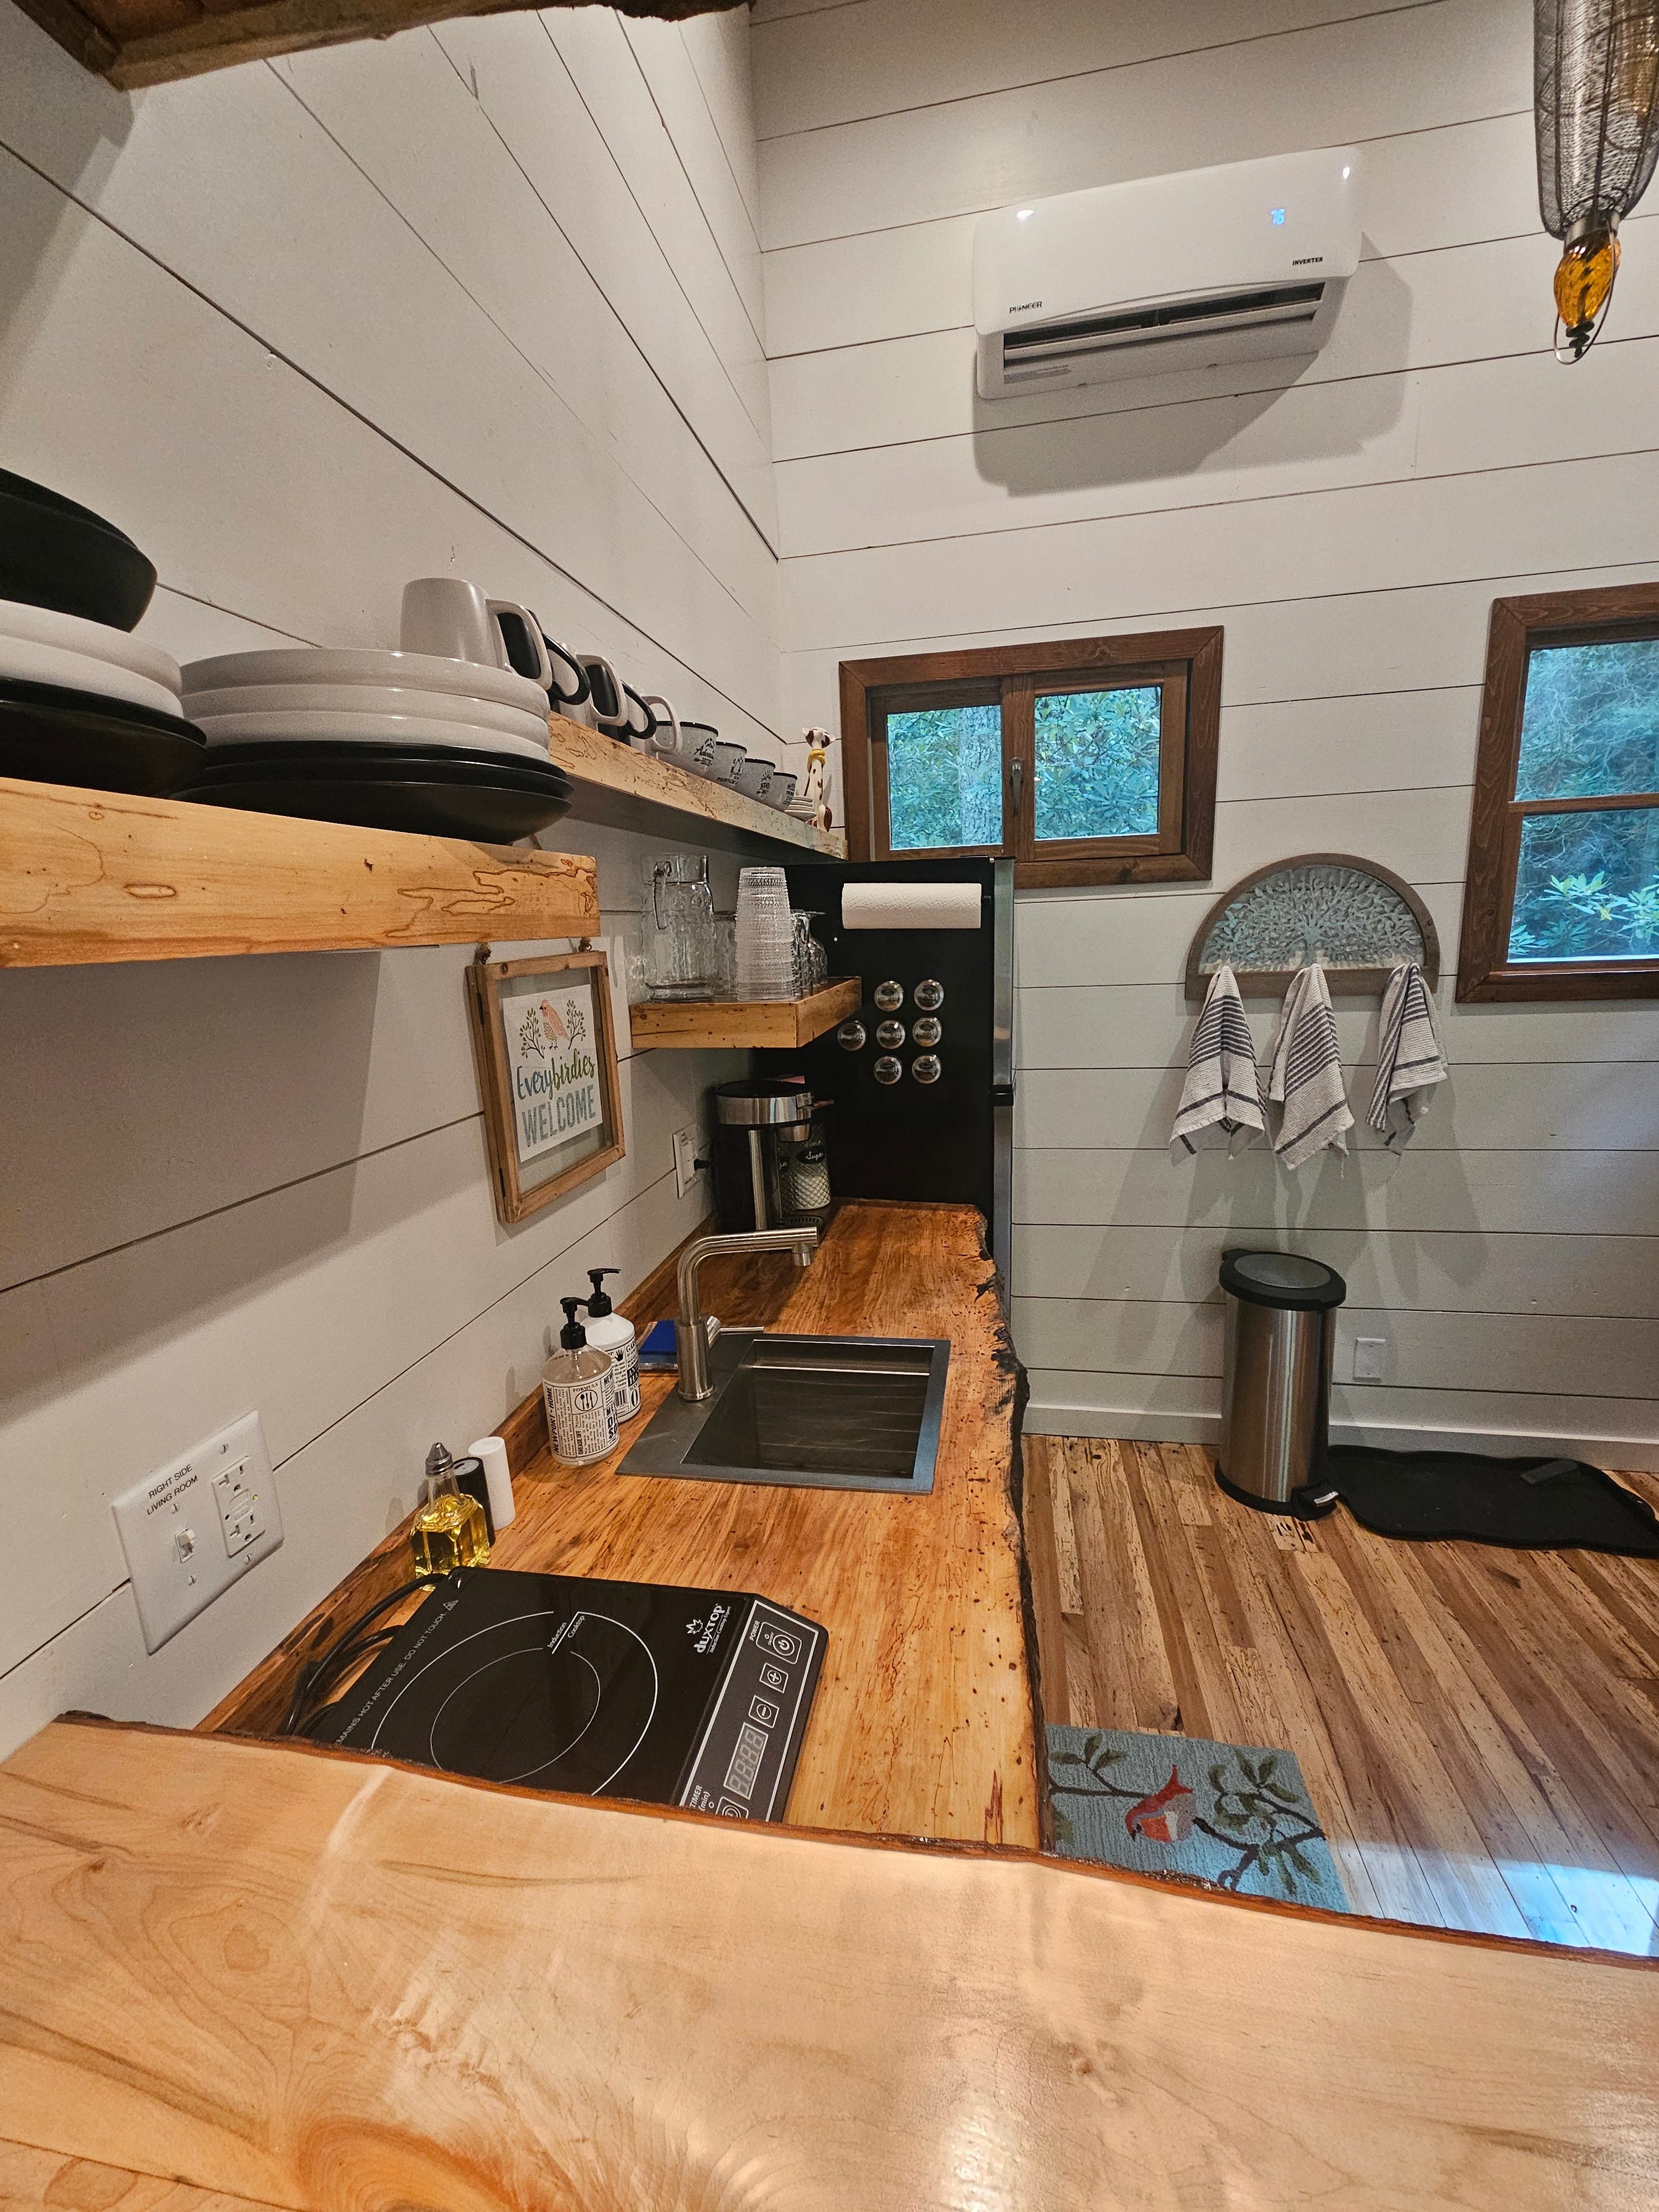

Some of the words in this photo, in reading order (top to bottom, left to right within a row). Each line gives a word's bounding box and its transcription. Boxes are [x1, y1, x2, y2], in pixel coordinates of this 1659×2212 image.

[1292, 257, 1323, 266] INVERTER
[1009, 301, 1042, 314] PIONEER
[521, 1084, 596, 1147] WELCOME
[573, 1383, 598, 1392] FORMULA
[550, 1415, 560, 1453] NEWPORT
[148, 1477, 172, 1499] RIGHT
[174, 1464, 192, 1480] SIDE
[147, 1493, 173, 1515] LIVING
[174, 1475, 198, 1496] ROOM
[547, 1623, 567, 1648] Induction
[567, 1615, 585, 1638] Cooktop
[749, 1620, 760, 1641] POWER
[709, 1634, 720, 1653] Induction
[358, 1700, 374, 1717] HOT
[372, 1677, 394, 1700] AFTER
[404, 1648, 416, 1660] DO
[414, 1634, 427, 1648] NOT
[690, 1785, 703, 1808] TIMER
[698, 1791, 711, 1811] (min)
